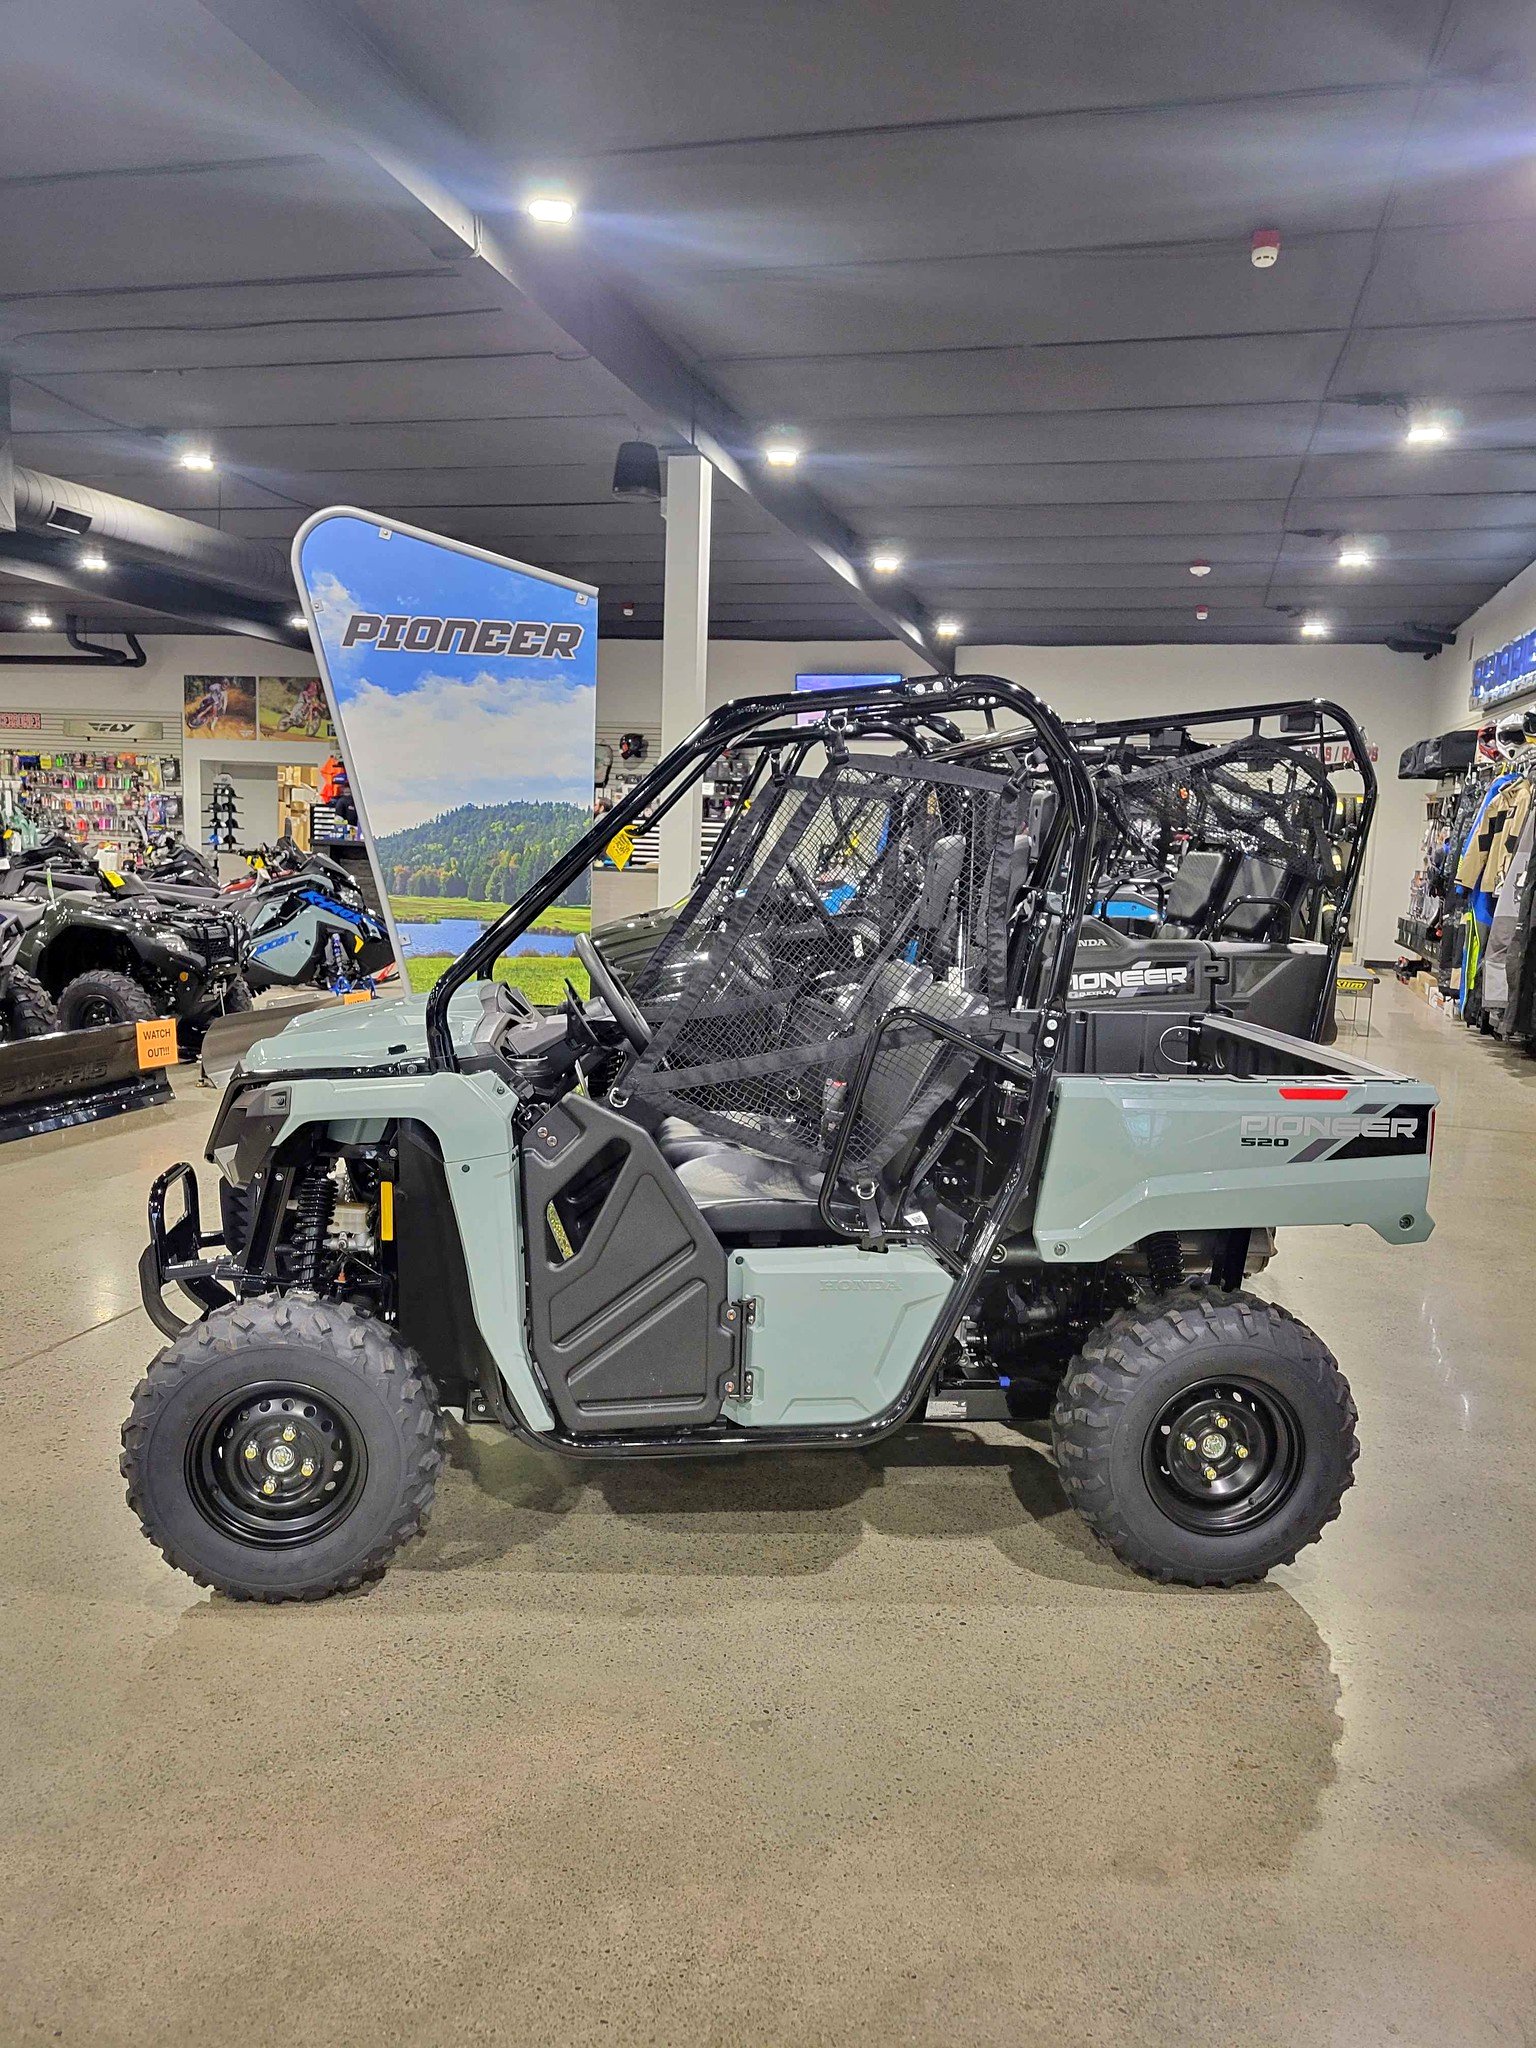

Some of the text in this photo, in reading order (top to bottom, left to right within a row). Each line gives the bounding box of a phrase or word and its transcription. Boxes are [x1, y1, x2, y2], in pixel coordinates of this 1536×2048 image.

[342, 614, 584, 660] PIONEER
[1077, 938, 1108, 947] NDA
[1070, 967, 1187, 990] IONEER
[143, 1028, 171, 1040] WATCH
[147, 1047, 170, 1058] OUT!!!
[1240, 1115, 1419, 1139] PIONEER
[1240, 1137, 1290, 1147] 520
[819, 1279, 903, 1292] HONDA
